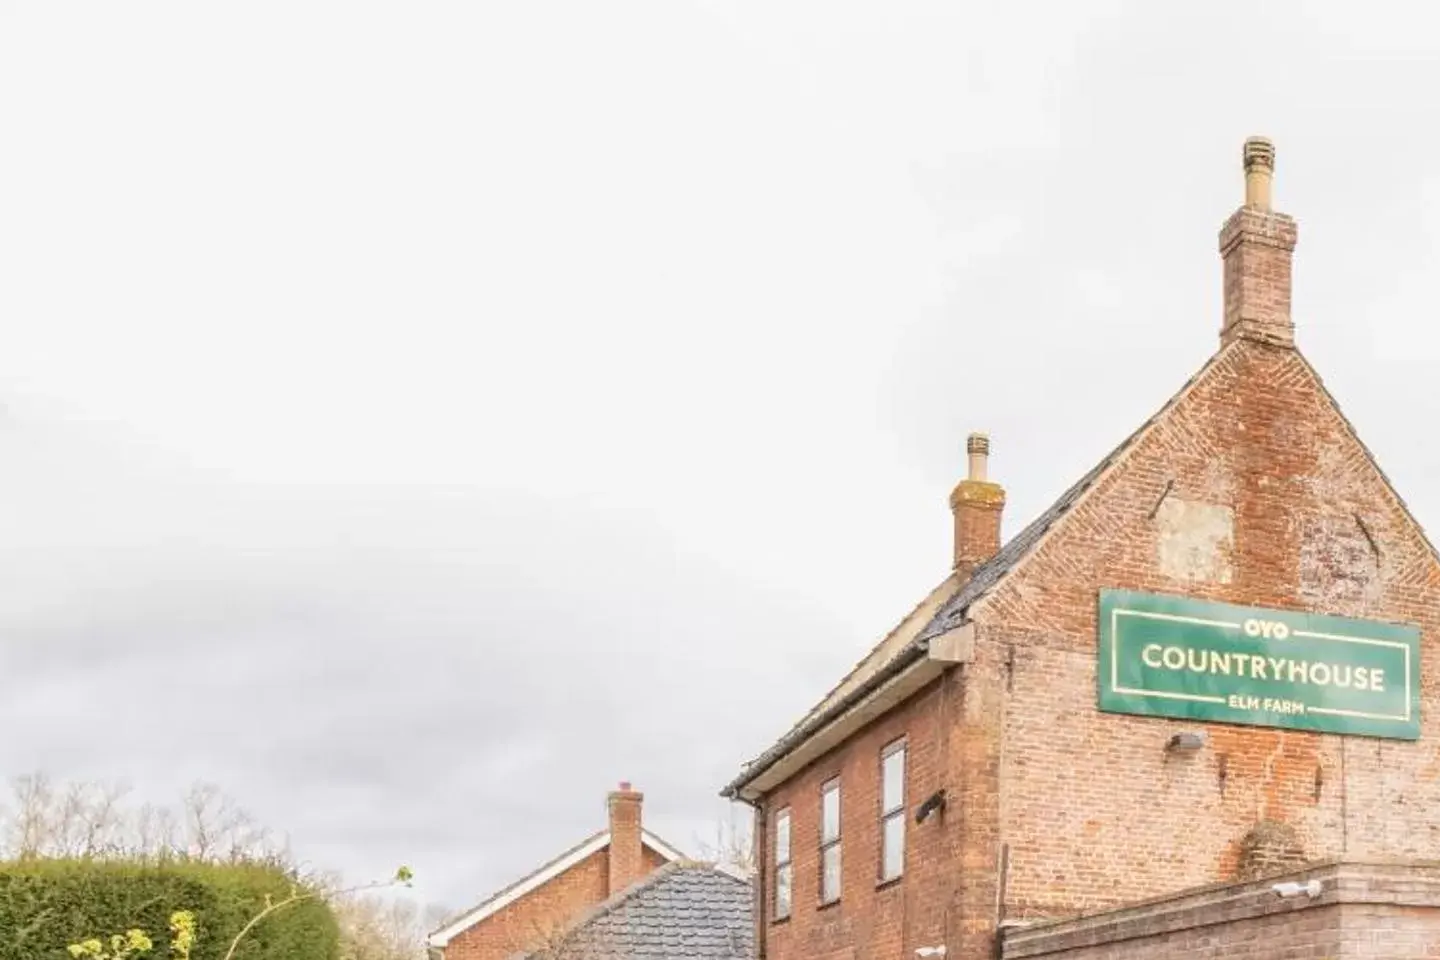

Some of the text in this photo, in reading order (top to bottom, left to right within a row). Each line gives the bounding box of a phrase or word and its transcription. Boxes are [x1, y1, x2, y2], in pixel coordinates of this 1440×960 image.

[1245, 620, 1289, 639] OYO
[1142, 644, 1385, 692] COUNTRYHOUSE
[1228, 695, 1304, 714] ELM FARM
